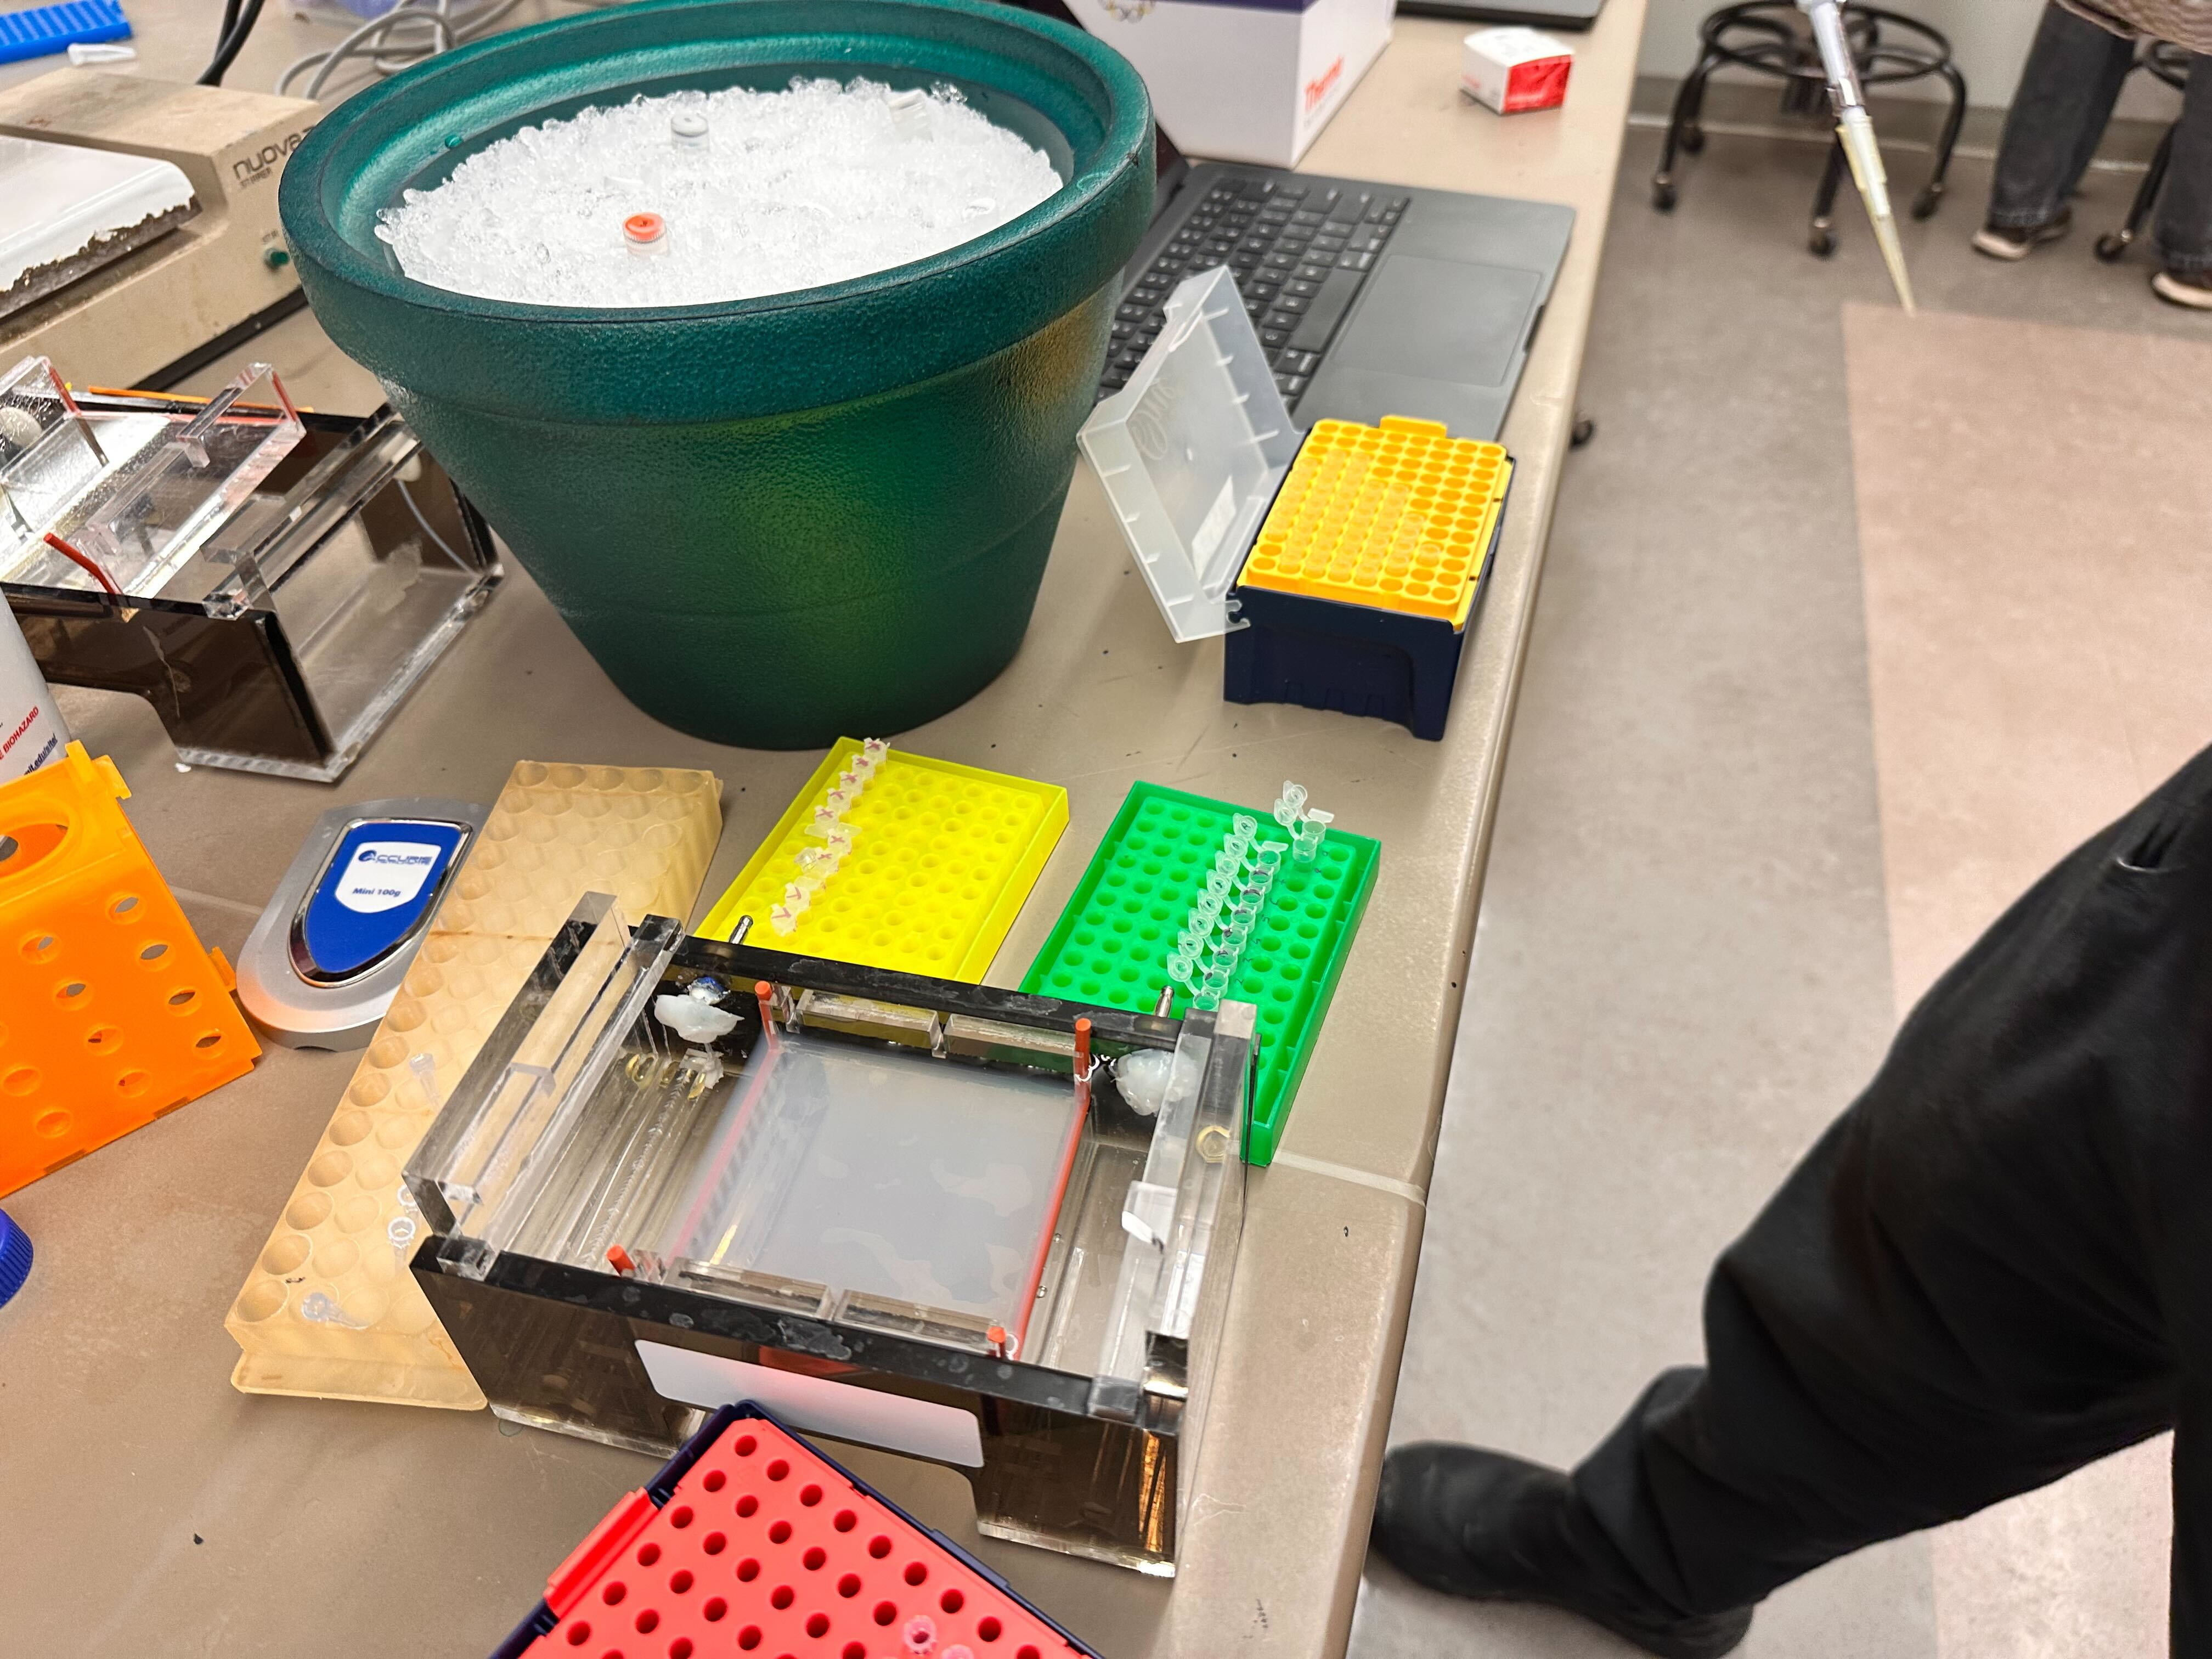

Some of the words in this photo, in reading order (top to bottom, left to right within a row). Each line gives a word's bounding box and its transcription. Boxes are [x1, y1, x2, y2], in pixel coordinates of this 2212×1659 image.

[233, 133, 302, 180] nuova
[3, 706, 39, 753] BIOHAZARD
[377, 889, 402, 898] 100g
